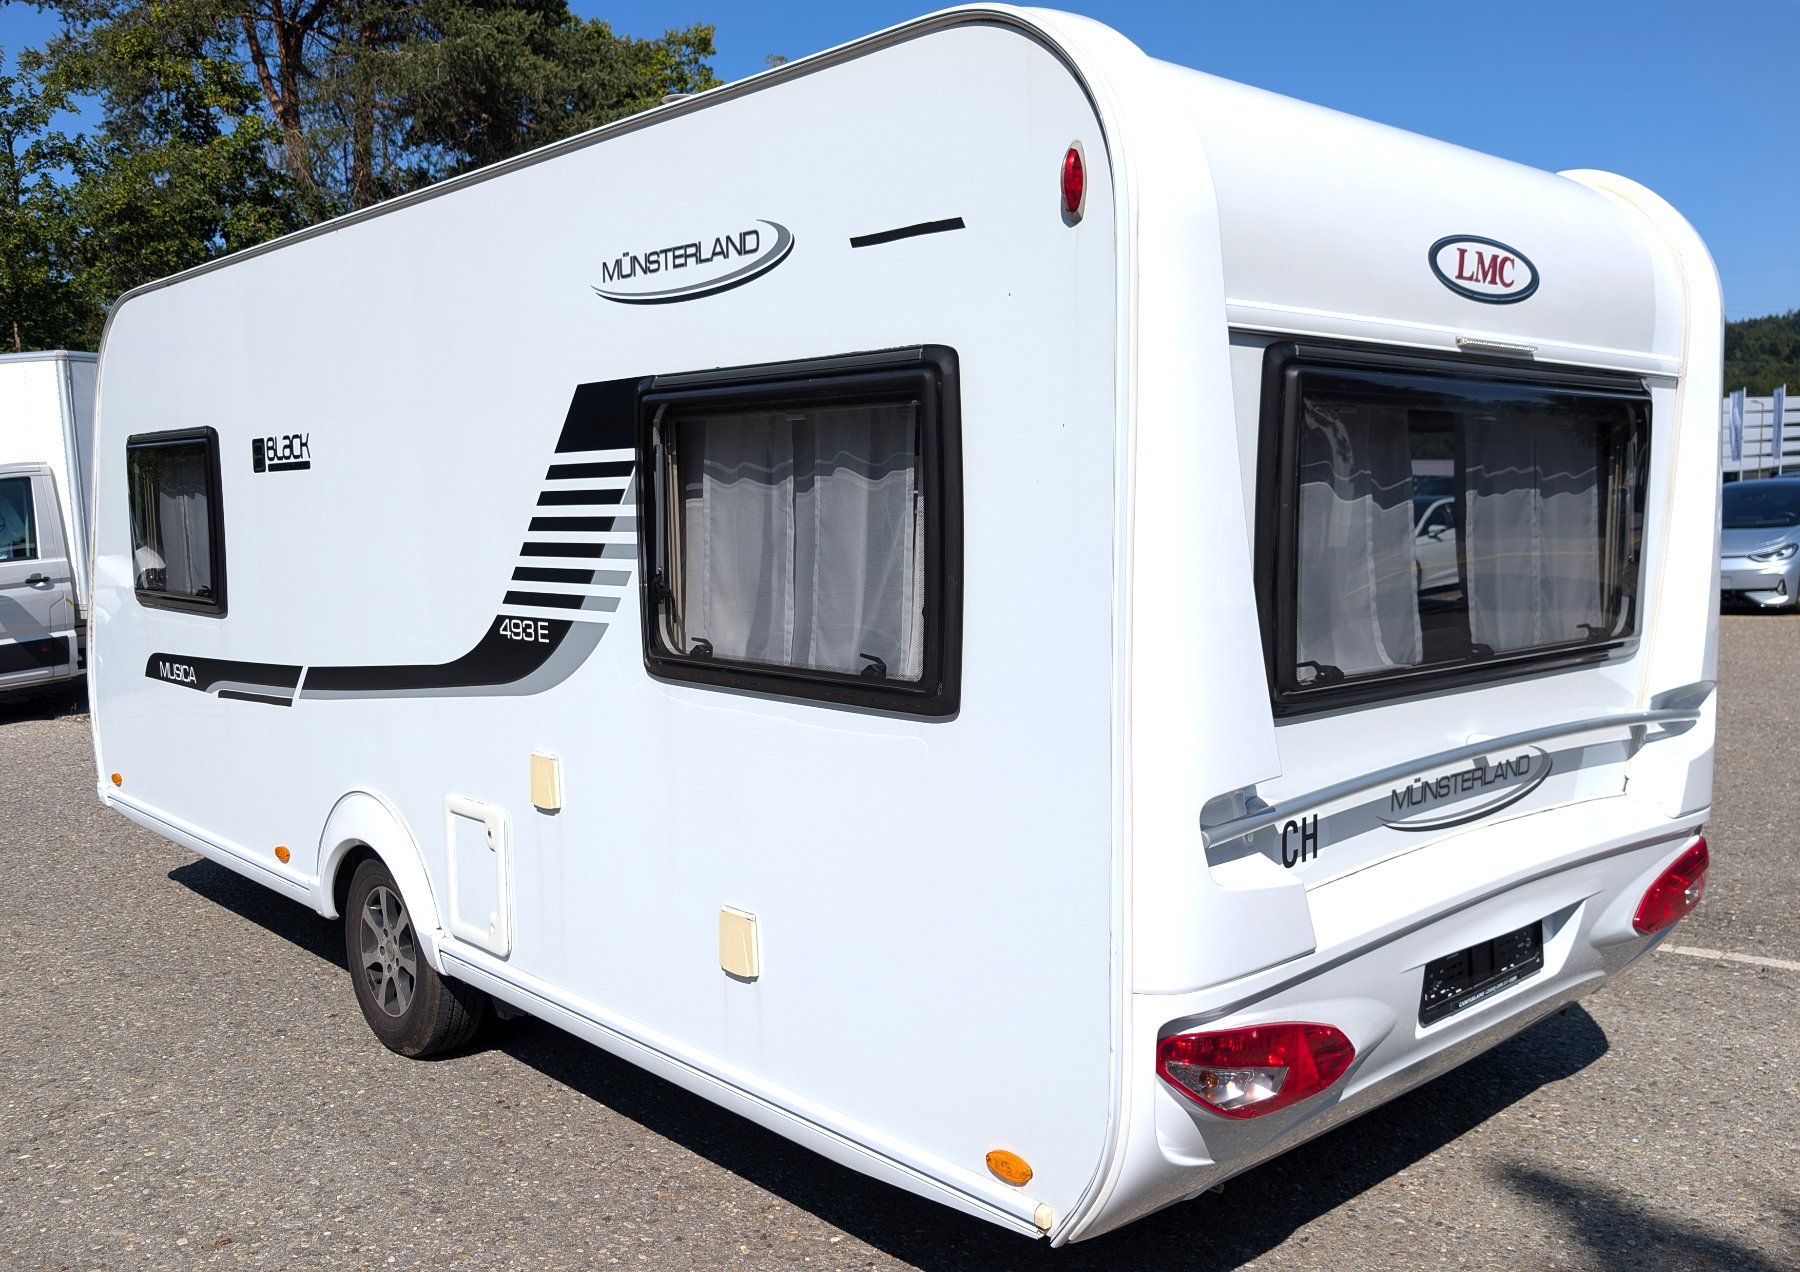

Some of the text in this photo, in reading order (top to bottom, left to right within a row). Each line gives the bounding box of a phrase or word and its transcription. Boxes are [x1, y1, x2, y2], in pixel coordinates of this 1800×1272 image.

[602, 229, 760, 284] MÜNSTERLAND
[1455, 247, 1515, 288] LMC
[500, 619, 535, 641] 493
[159, 660, 198, 684] MUSICA
[1390, 754, 1531, 813] MÜNSTERLAND
[1281, 813, 1319, 869] CH
